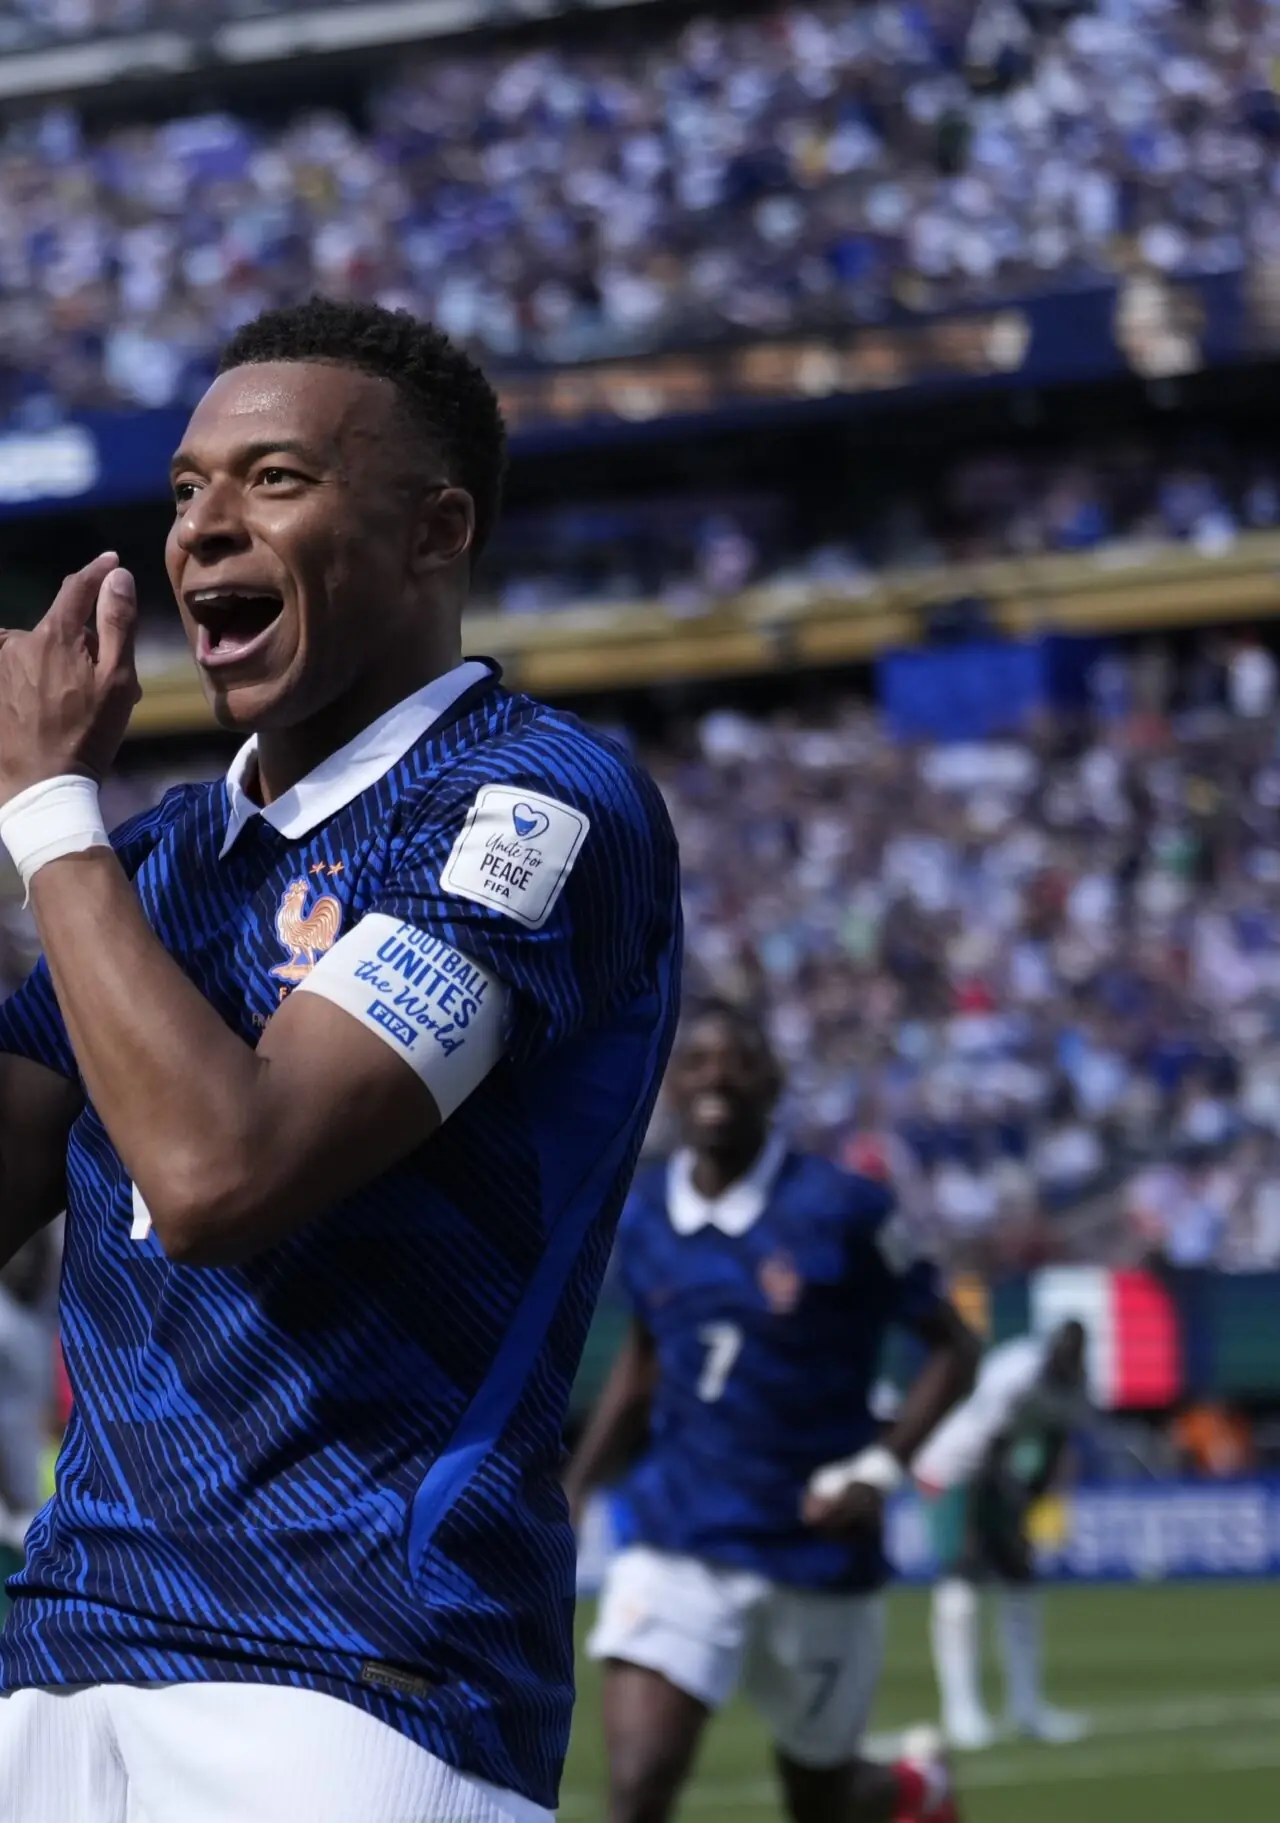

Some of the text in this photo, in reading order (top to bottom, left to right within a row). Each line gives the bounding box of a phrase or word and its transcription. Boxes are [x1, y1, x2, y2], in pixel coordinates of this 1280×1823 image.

[480, 853, 533, 891] PEACE
[485, 833, 543, 869] Unite For
[484, 879, 510, 898] FIFA
[376, 936, 477, 1029] UNITES
[396, 922, 489, 1005] FOOTBALL
[353, 959, 465, 1058] the World
[372, 1004, 412, 1045] FIFA
[698, 1321, 744, 1403] 7
